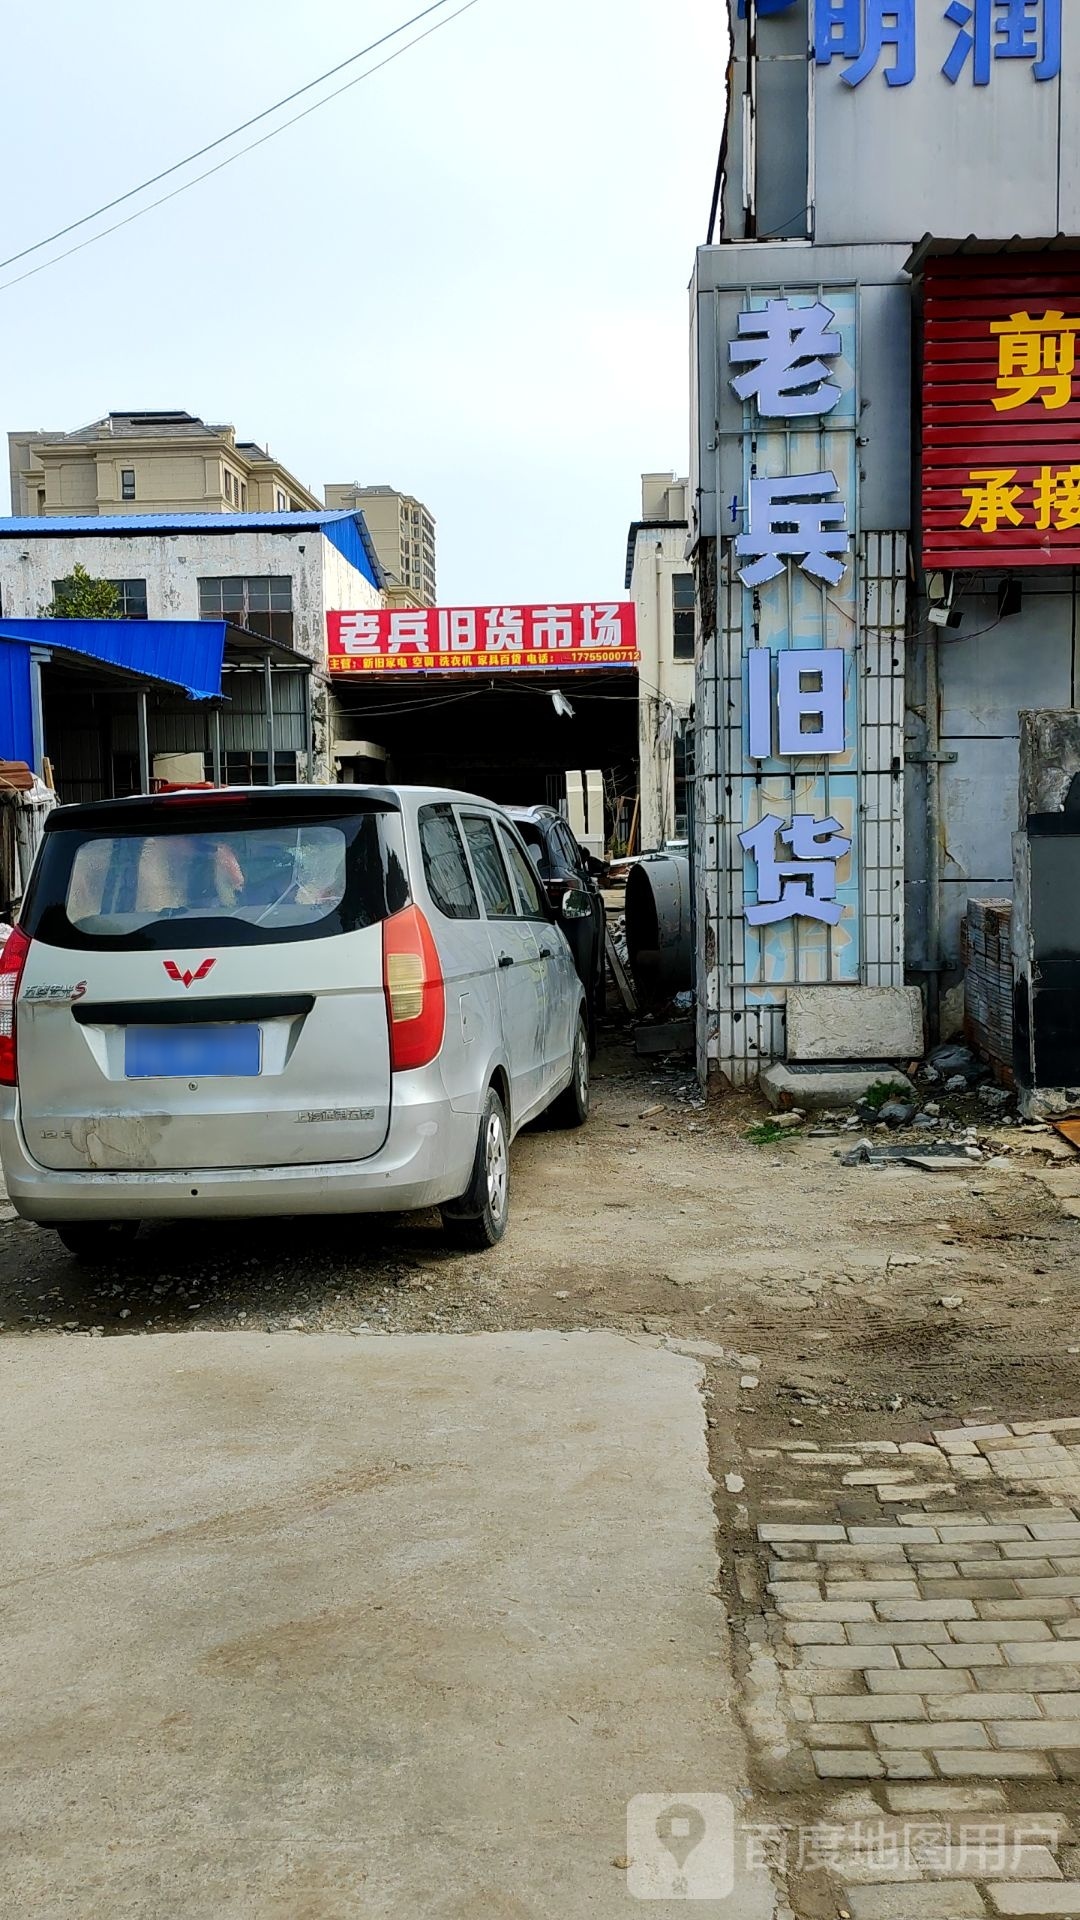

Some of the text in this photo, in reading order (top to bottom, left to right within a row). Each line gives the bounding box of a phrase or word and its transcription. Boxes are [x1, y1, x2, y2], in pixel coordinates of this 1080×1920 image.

[737, 0, 1060, 87] 明润
[960, 465, 1080, 533] 承接
[339, 604, 622, 654] 老兵旧货市场
[728, 298, 852, 927] 老兵旧货
[363, 656, 407, 669] 新旧家电
[412, 655, 435, 668] 空调
[439, 654, 472, 667] 洗衣机
[477, 653, 522, 666] 家具百货
[571, 650, 640, 661] 17755000712
